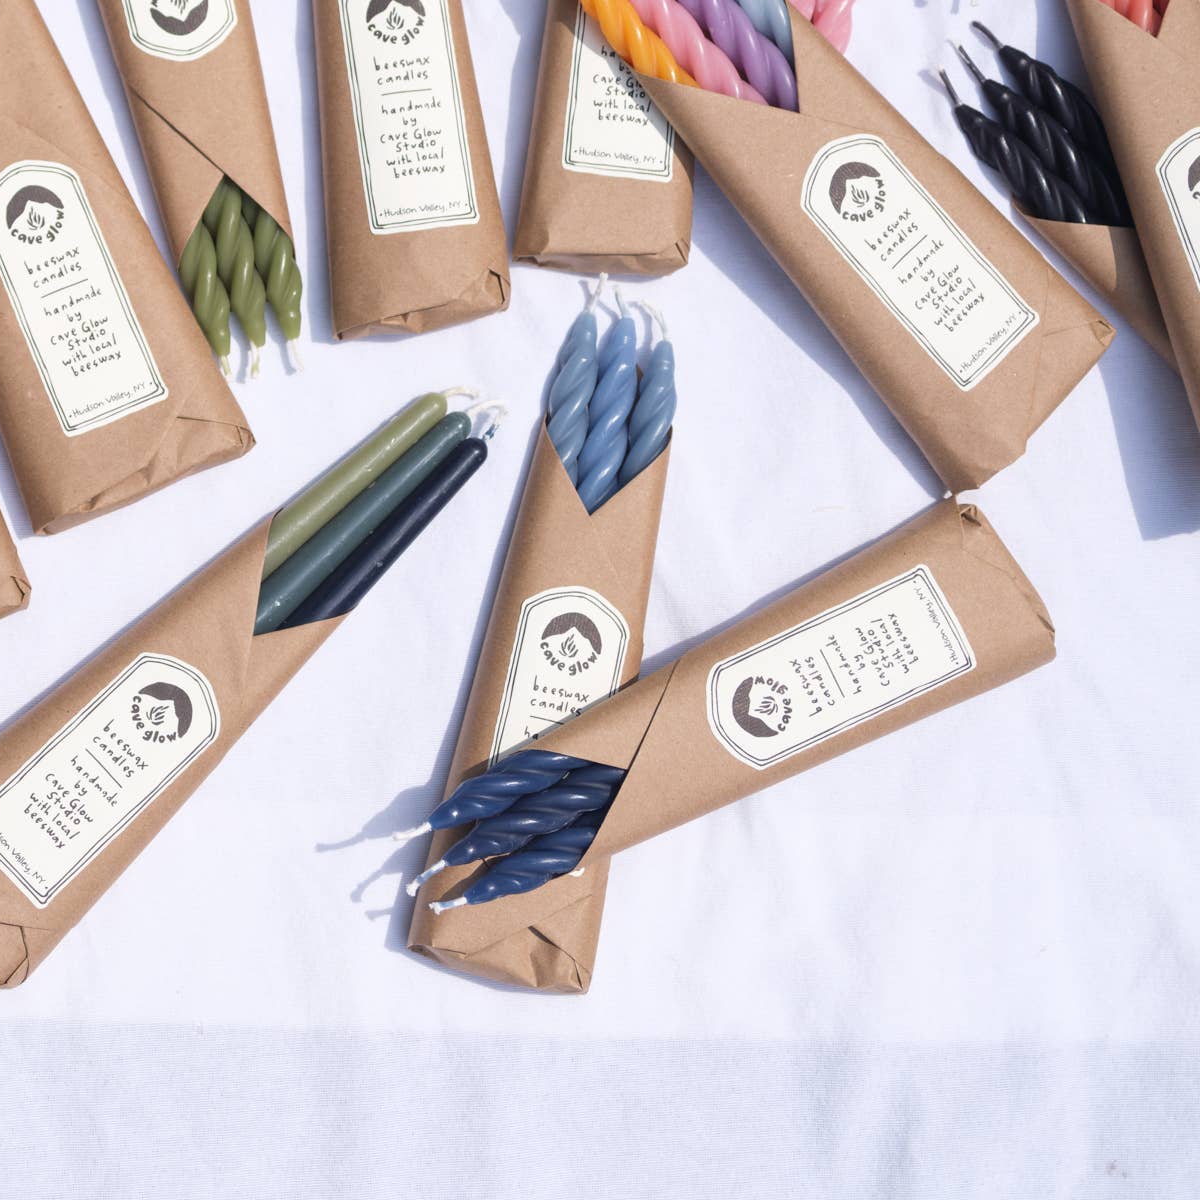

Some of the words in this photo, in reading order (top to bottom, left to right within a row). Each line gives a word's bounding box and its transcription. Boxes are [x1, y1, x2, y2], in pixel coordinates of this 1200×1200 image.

[366, 22, 398, 45] cave
[400, 15, 425, 46] glow
[372, 55, 429, 72] beeswax
[376, 69, 428, 86] candles
[592, 98, 618, 109] with
[623, 96, 652, 113] local
[597, 108, 649, 127] beeswax
[841, 208, 874, 223] cave
[873, 174, 886, 213] glow
[9, 228, 43, 245] cave
[45, 207, 65, 243] glow
[863, 207, 911, 252] beeswax
[879, 221, 918, 262] candles
[23, 246, 80, 276] beeswax
[32, 261, 82, 289] candles
[897, 239, 945, 285] handmade
[921, 268, 936, 283] by
[937, 263, 960, 288] Glow
[931, 276, 963, 310] Studio
[933, 304, 955, 326] with
[951, 277, 976, 305] local
[942, 292, 984, 333] beeswax
[1004, 313, 1017, 327] NY
[539, 641, 566, 671] cave
[567, 651, 600, 677] glow
[532, 674, 590, 703] beeswax
[750, 675, 788, 695] glow
[788, 658, 823, 717] beeswax
[803, 655, 836, 706] candles
[130, 694, 145, 730] cave
[141, 729, 181, 744] glow
[529, 698, 582, 717] candles
[777, 697, 793, 732] cave
[92, 735, 135, 778] candles
[102, 718, 149, 770] beeswax
[69, 754, 118, 807] handmade
[73, 780, 88, 797] by
[29, 792, 51, 816] with
[51, 812, 81, 840] local
[45, 790, 81, 825] Studio
[68, 797, 94, 823] Glow
[23, 802, 66, 849] beeswax
[31, 870, 46, 884] NY
